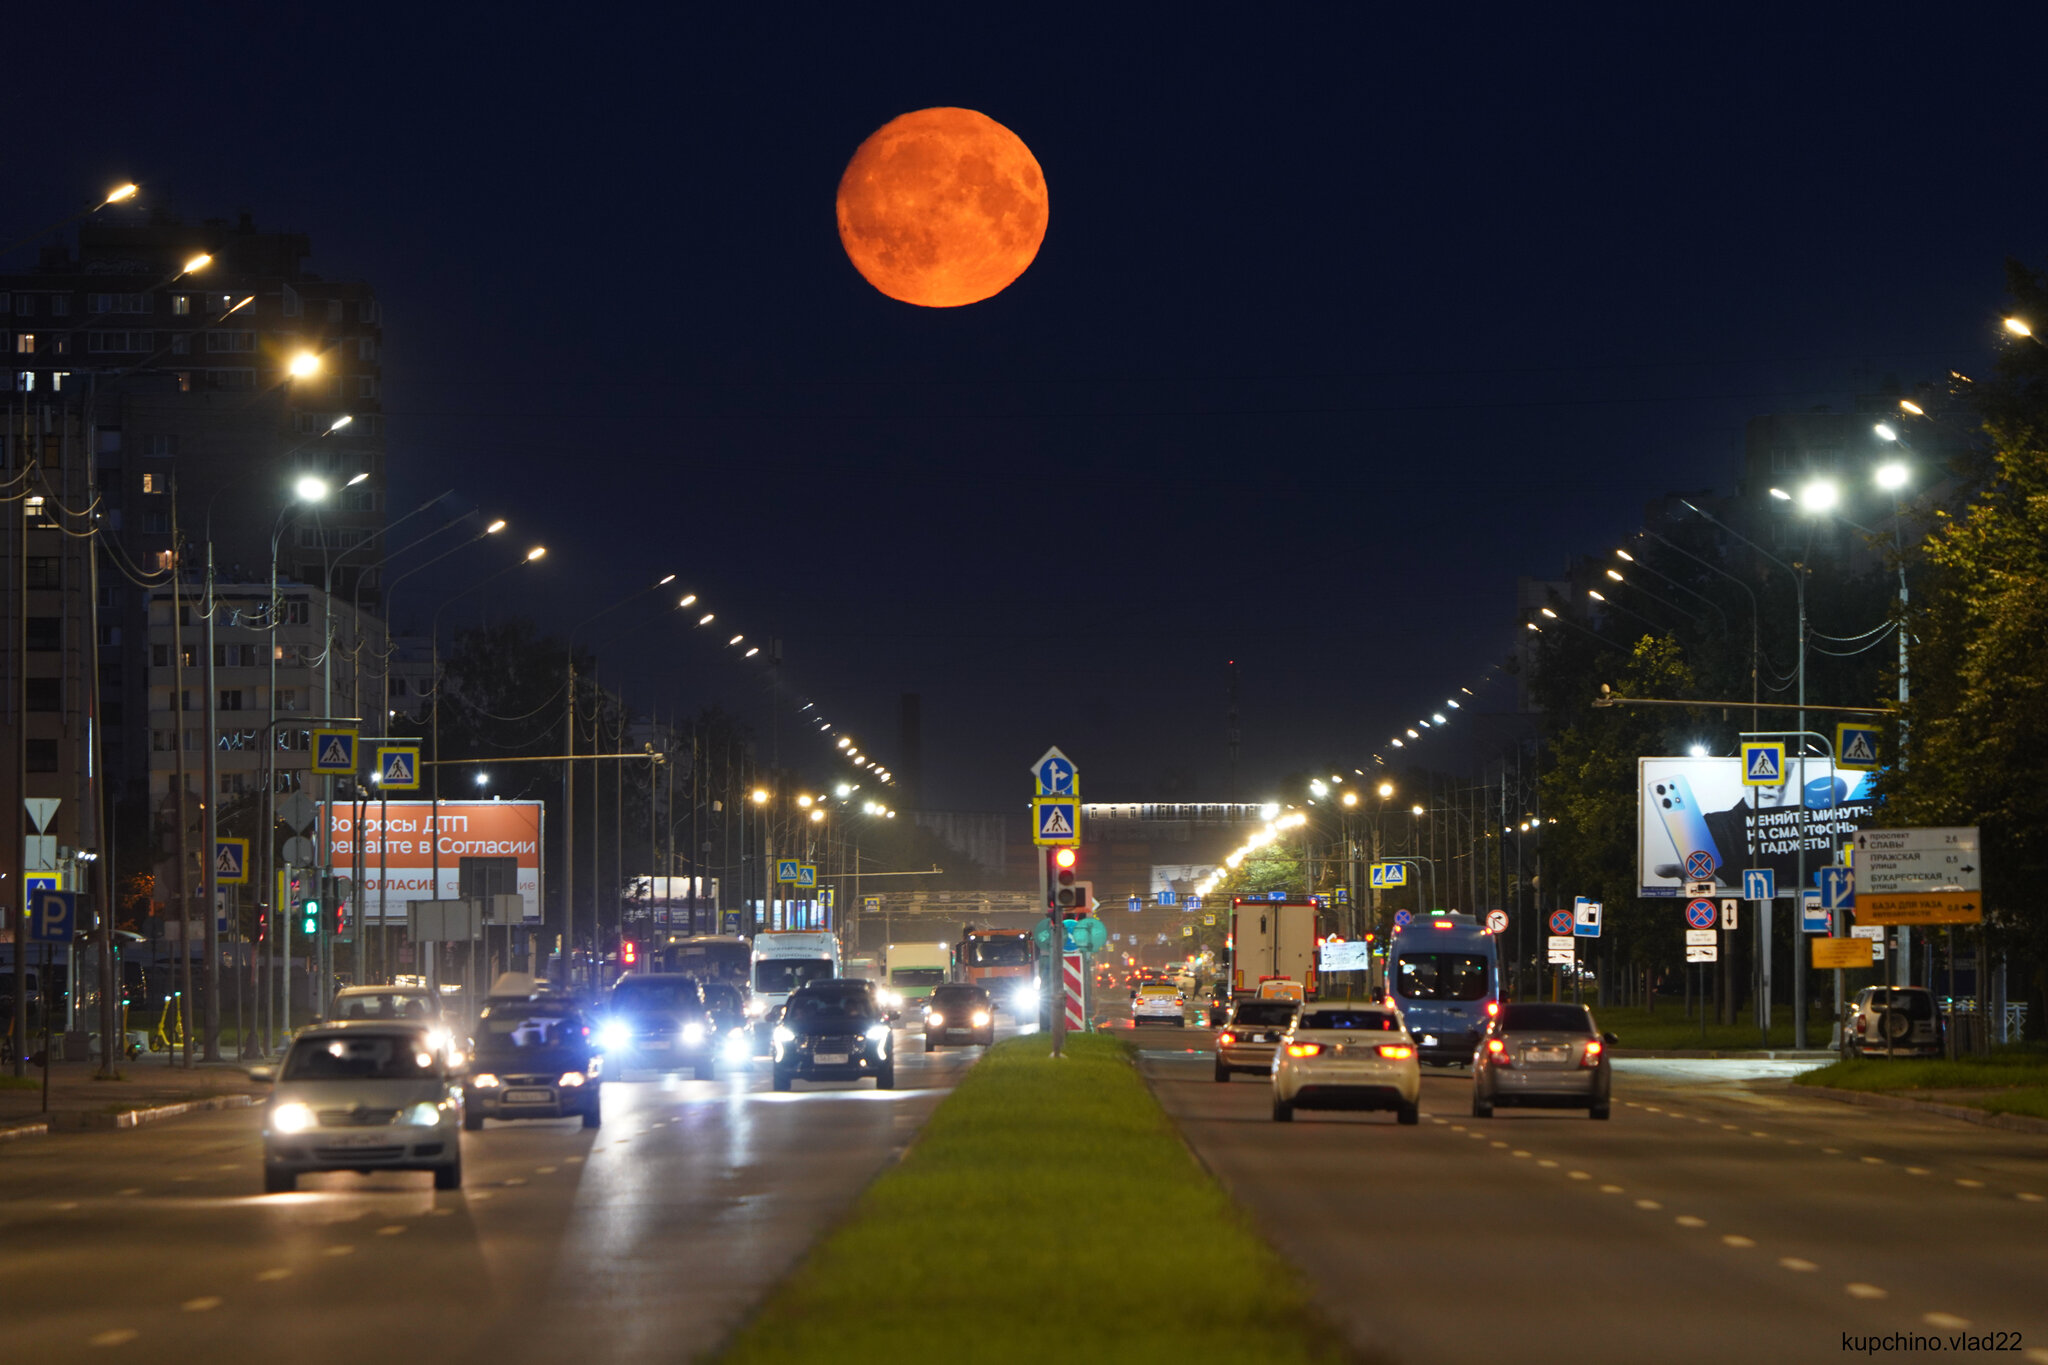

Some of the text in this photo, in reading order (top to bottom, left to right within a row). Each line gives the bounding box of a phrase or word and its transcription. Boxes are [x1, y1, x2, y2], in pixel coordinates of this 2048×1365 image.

[1746, 810, 1810, 827] МЕНЯЙТЕ
[331, 816, 468, 836] Воросы ДТП
[1746, 829, 1767, 841] НА
[1869, 832, 1910, 842] проспект
[418, 841, 431, 854] в
[437, 837, 536, 854] Согласии
[1760, 837, 1830, 855] ГАДЖЕТЫ
[1869, 841, 1904, 850] СЛАВЫ
[1869, 852, 1921, 862] ПРАЖСКАЯ
[1870, 862, 1897, 871] улица
[1870, 872, 1943, 883] БУХАРЕСТСКАЯ
[358, 879, 436, 891] ОГЛАСИЕ
[1870, 883, 1898, 892] улица
